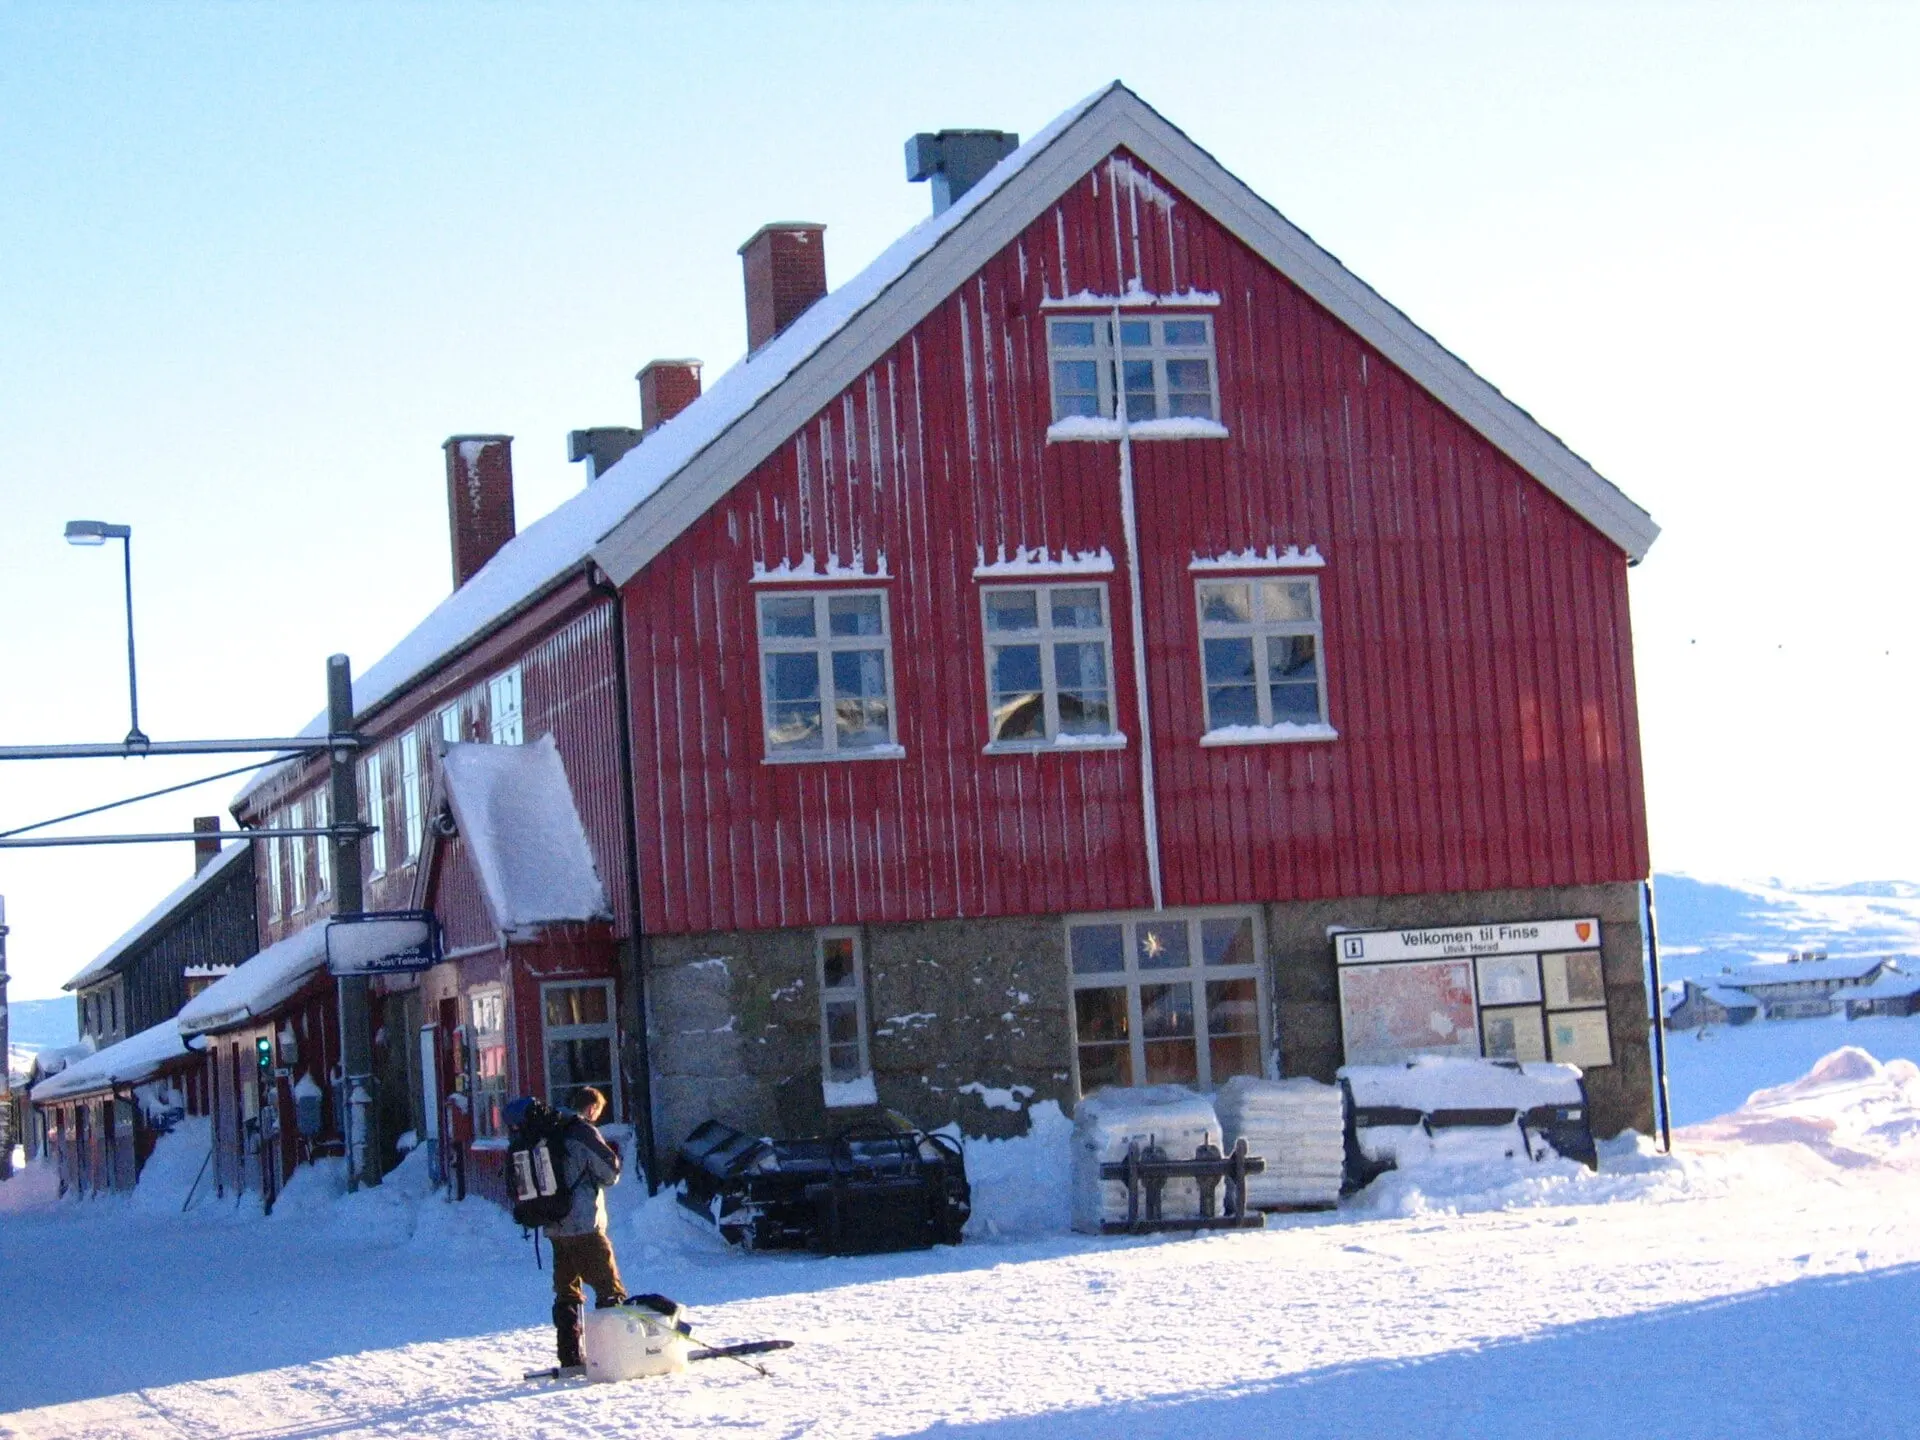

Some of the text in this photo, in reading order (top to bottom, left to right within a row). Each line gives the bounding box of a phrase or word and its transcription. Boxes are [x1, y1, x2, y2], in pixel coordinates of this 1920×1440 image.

[1401, 926, 1539, 946] Velkomen til Finse
